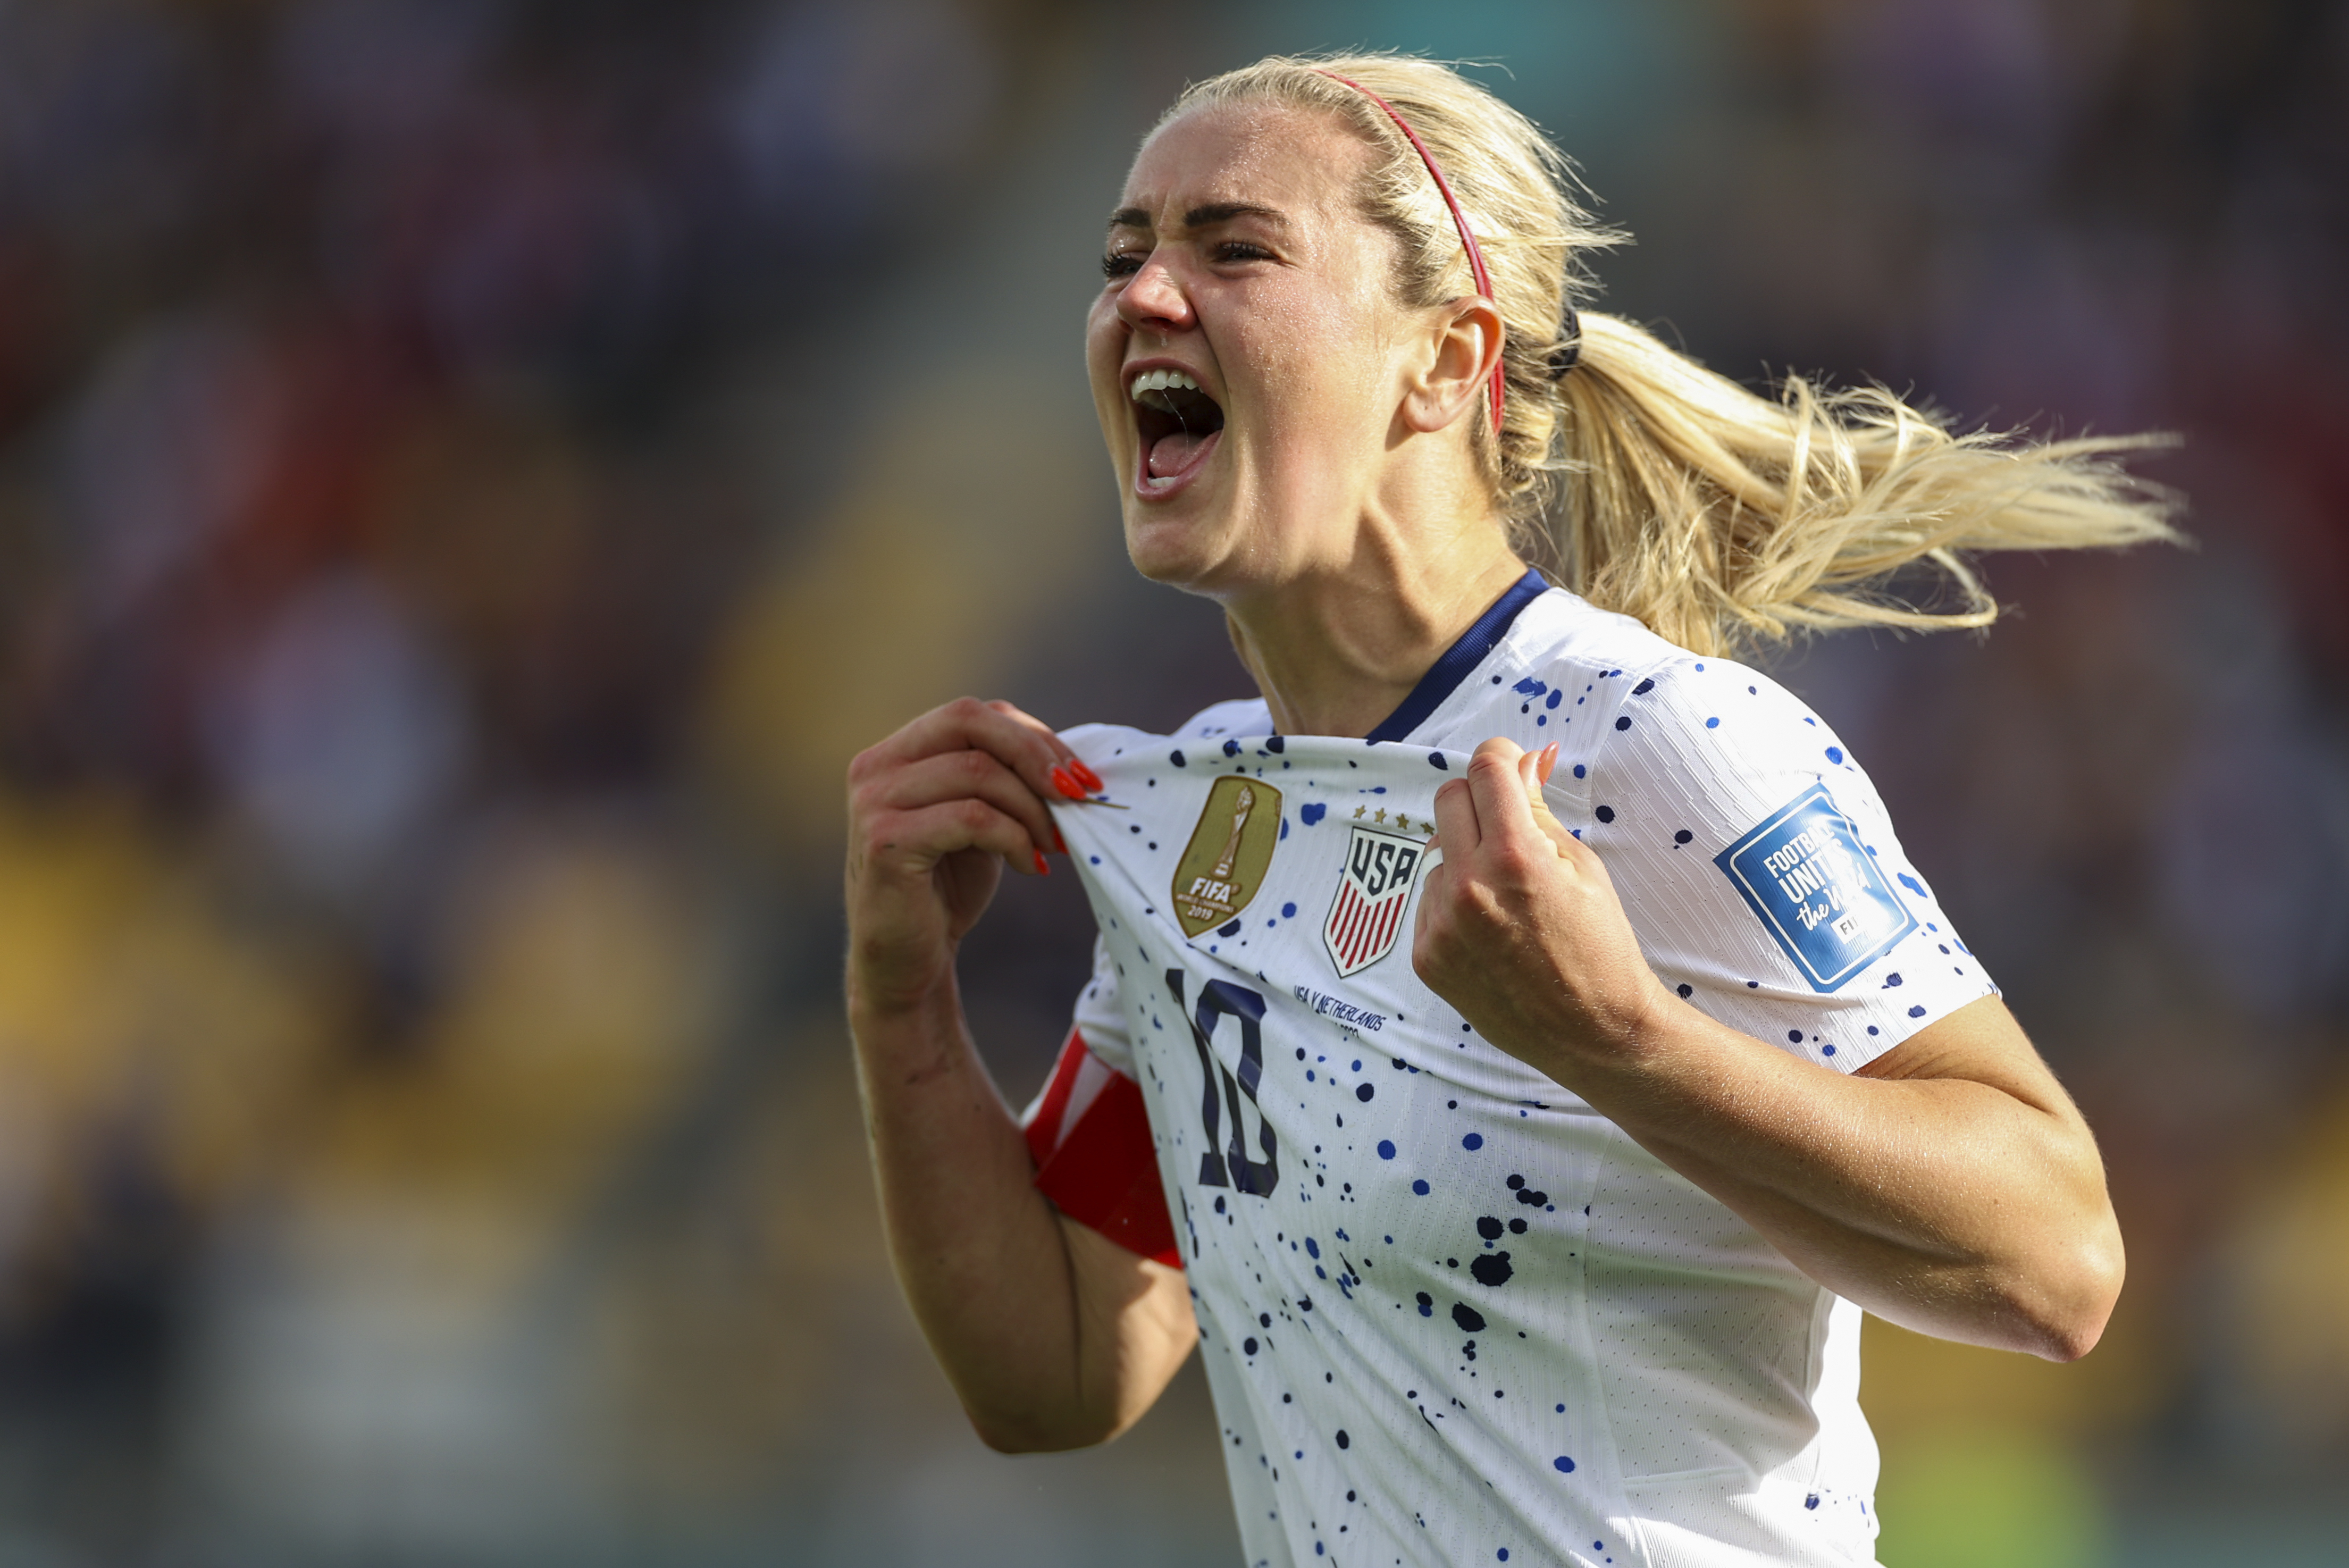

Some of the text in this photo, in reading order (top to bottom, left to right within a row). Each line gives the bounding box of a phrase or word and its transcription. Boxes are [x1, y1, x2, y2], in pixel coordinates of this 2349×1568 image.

[1189, 876, 1231, 903] FIFA
[1352, 837, 1418, 896] USA
[1778, 838, 1852, 904] UNITS
[1187, 904, 1214, 921] 2019
[1797, 901, 1829, 931] the
[1294, 985, 1309, 1007] USA
[1318, 994, 1387, 1032] NETHERLANDS
[1165, 968, 1280, 1199] 10
